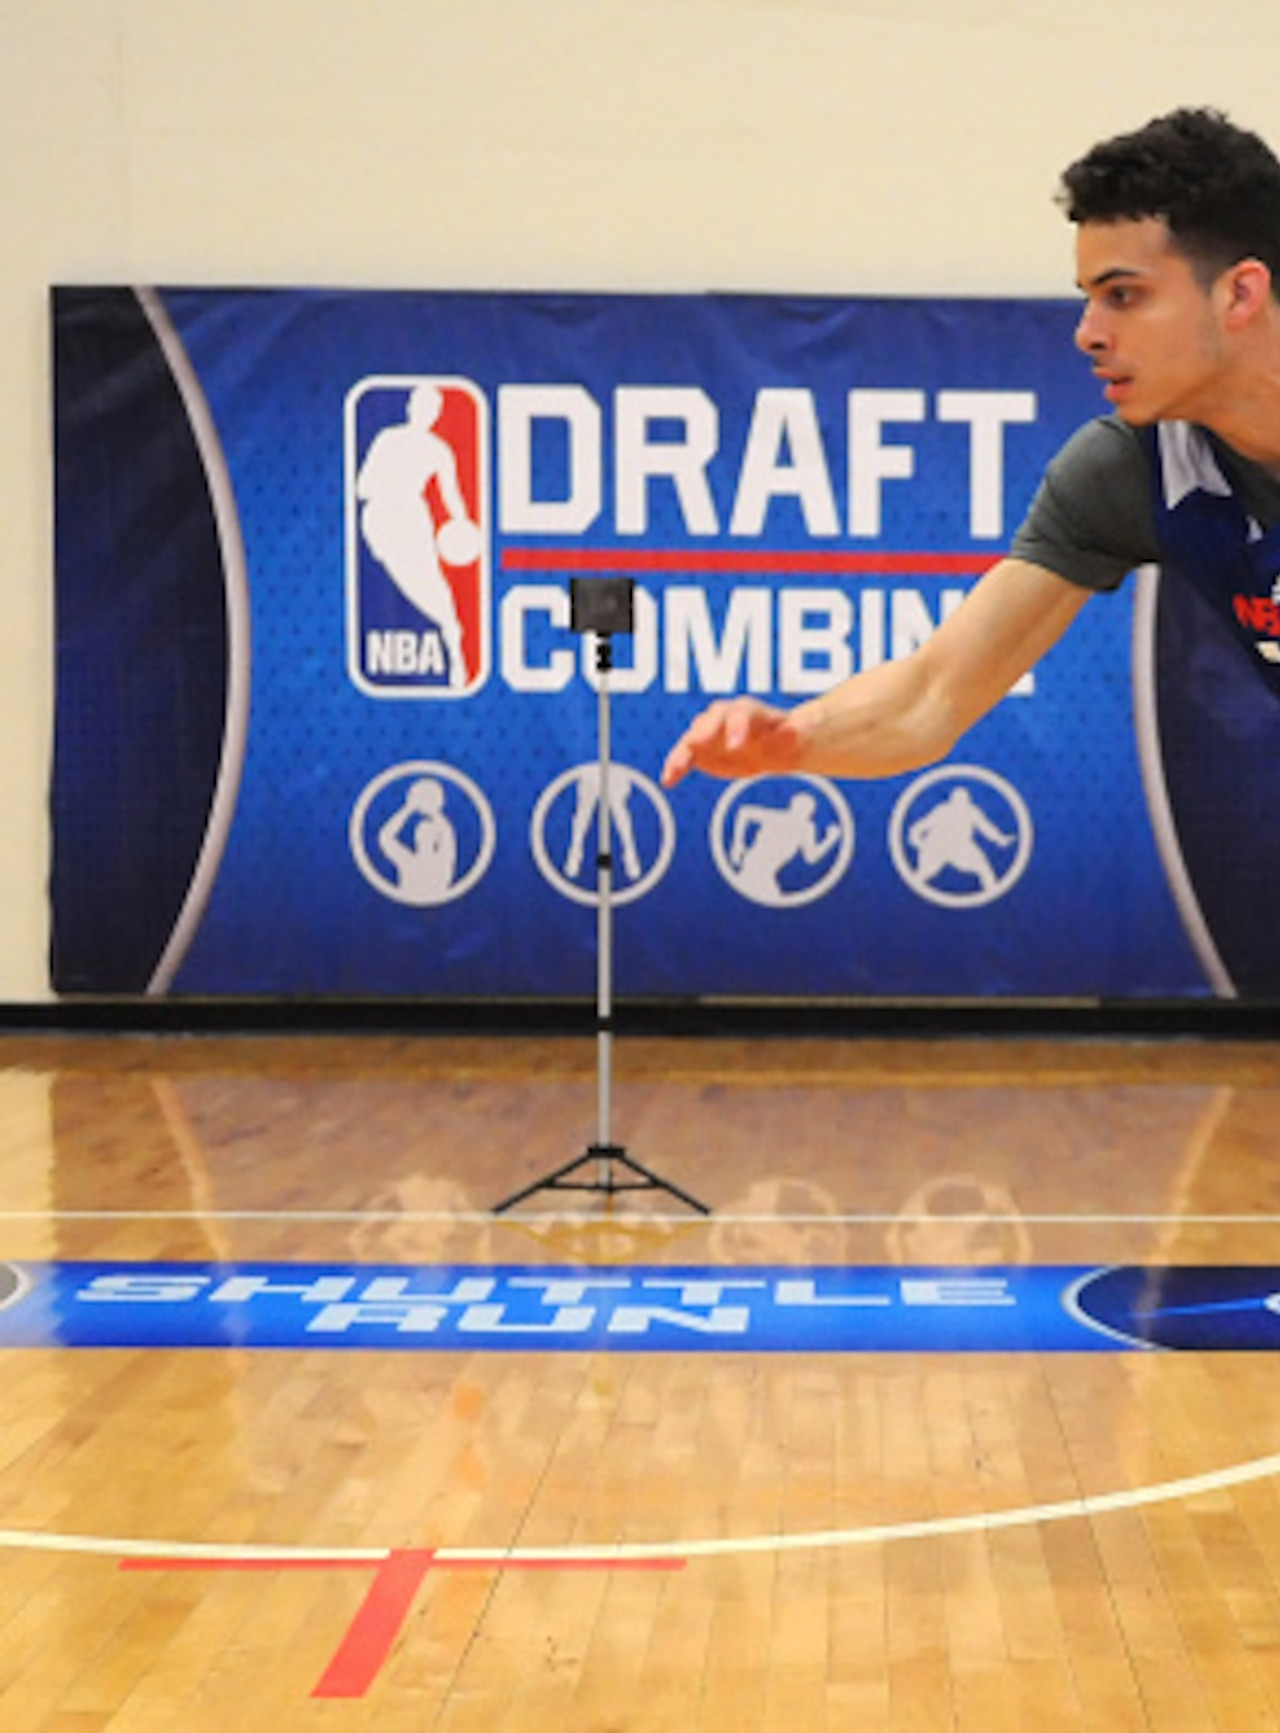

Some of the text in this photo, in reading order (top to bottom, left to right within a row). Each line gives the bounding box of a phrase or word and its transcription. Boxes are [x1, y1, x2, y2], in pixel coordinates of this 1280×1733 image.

[498, 384, 1037, 539] DRAFT
[366, 629, 446, 675] NBA
[501, 584, 1034, 695] COMBIN
[76, 1275, 1017, 1305] SHUTTLE
[306, 1303, 750, 1333] RUN
